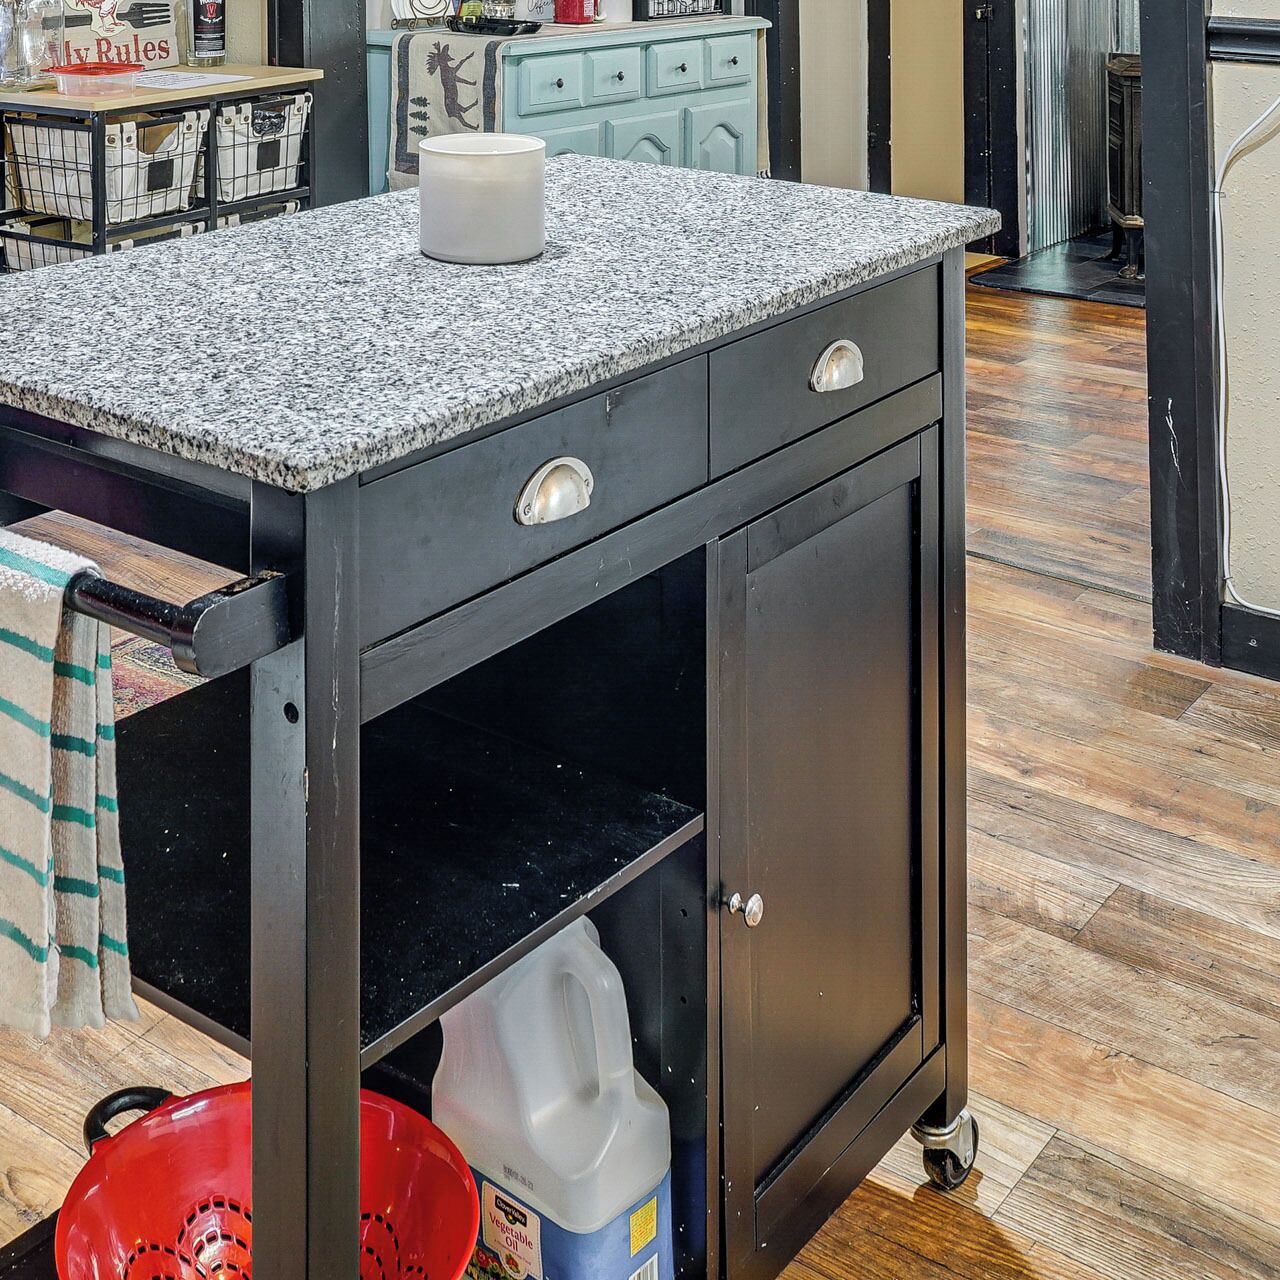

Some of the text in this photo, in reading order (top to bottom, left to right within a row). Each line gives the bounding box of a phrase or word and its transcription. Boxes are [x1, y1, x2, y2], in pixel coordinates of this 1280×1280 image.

[96, 34, 170, 64] Rules
[489, 1212, 534, 1250] Vegetable
[505, 1236, 518, 1252] Oil
